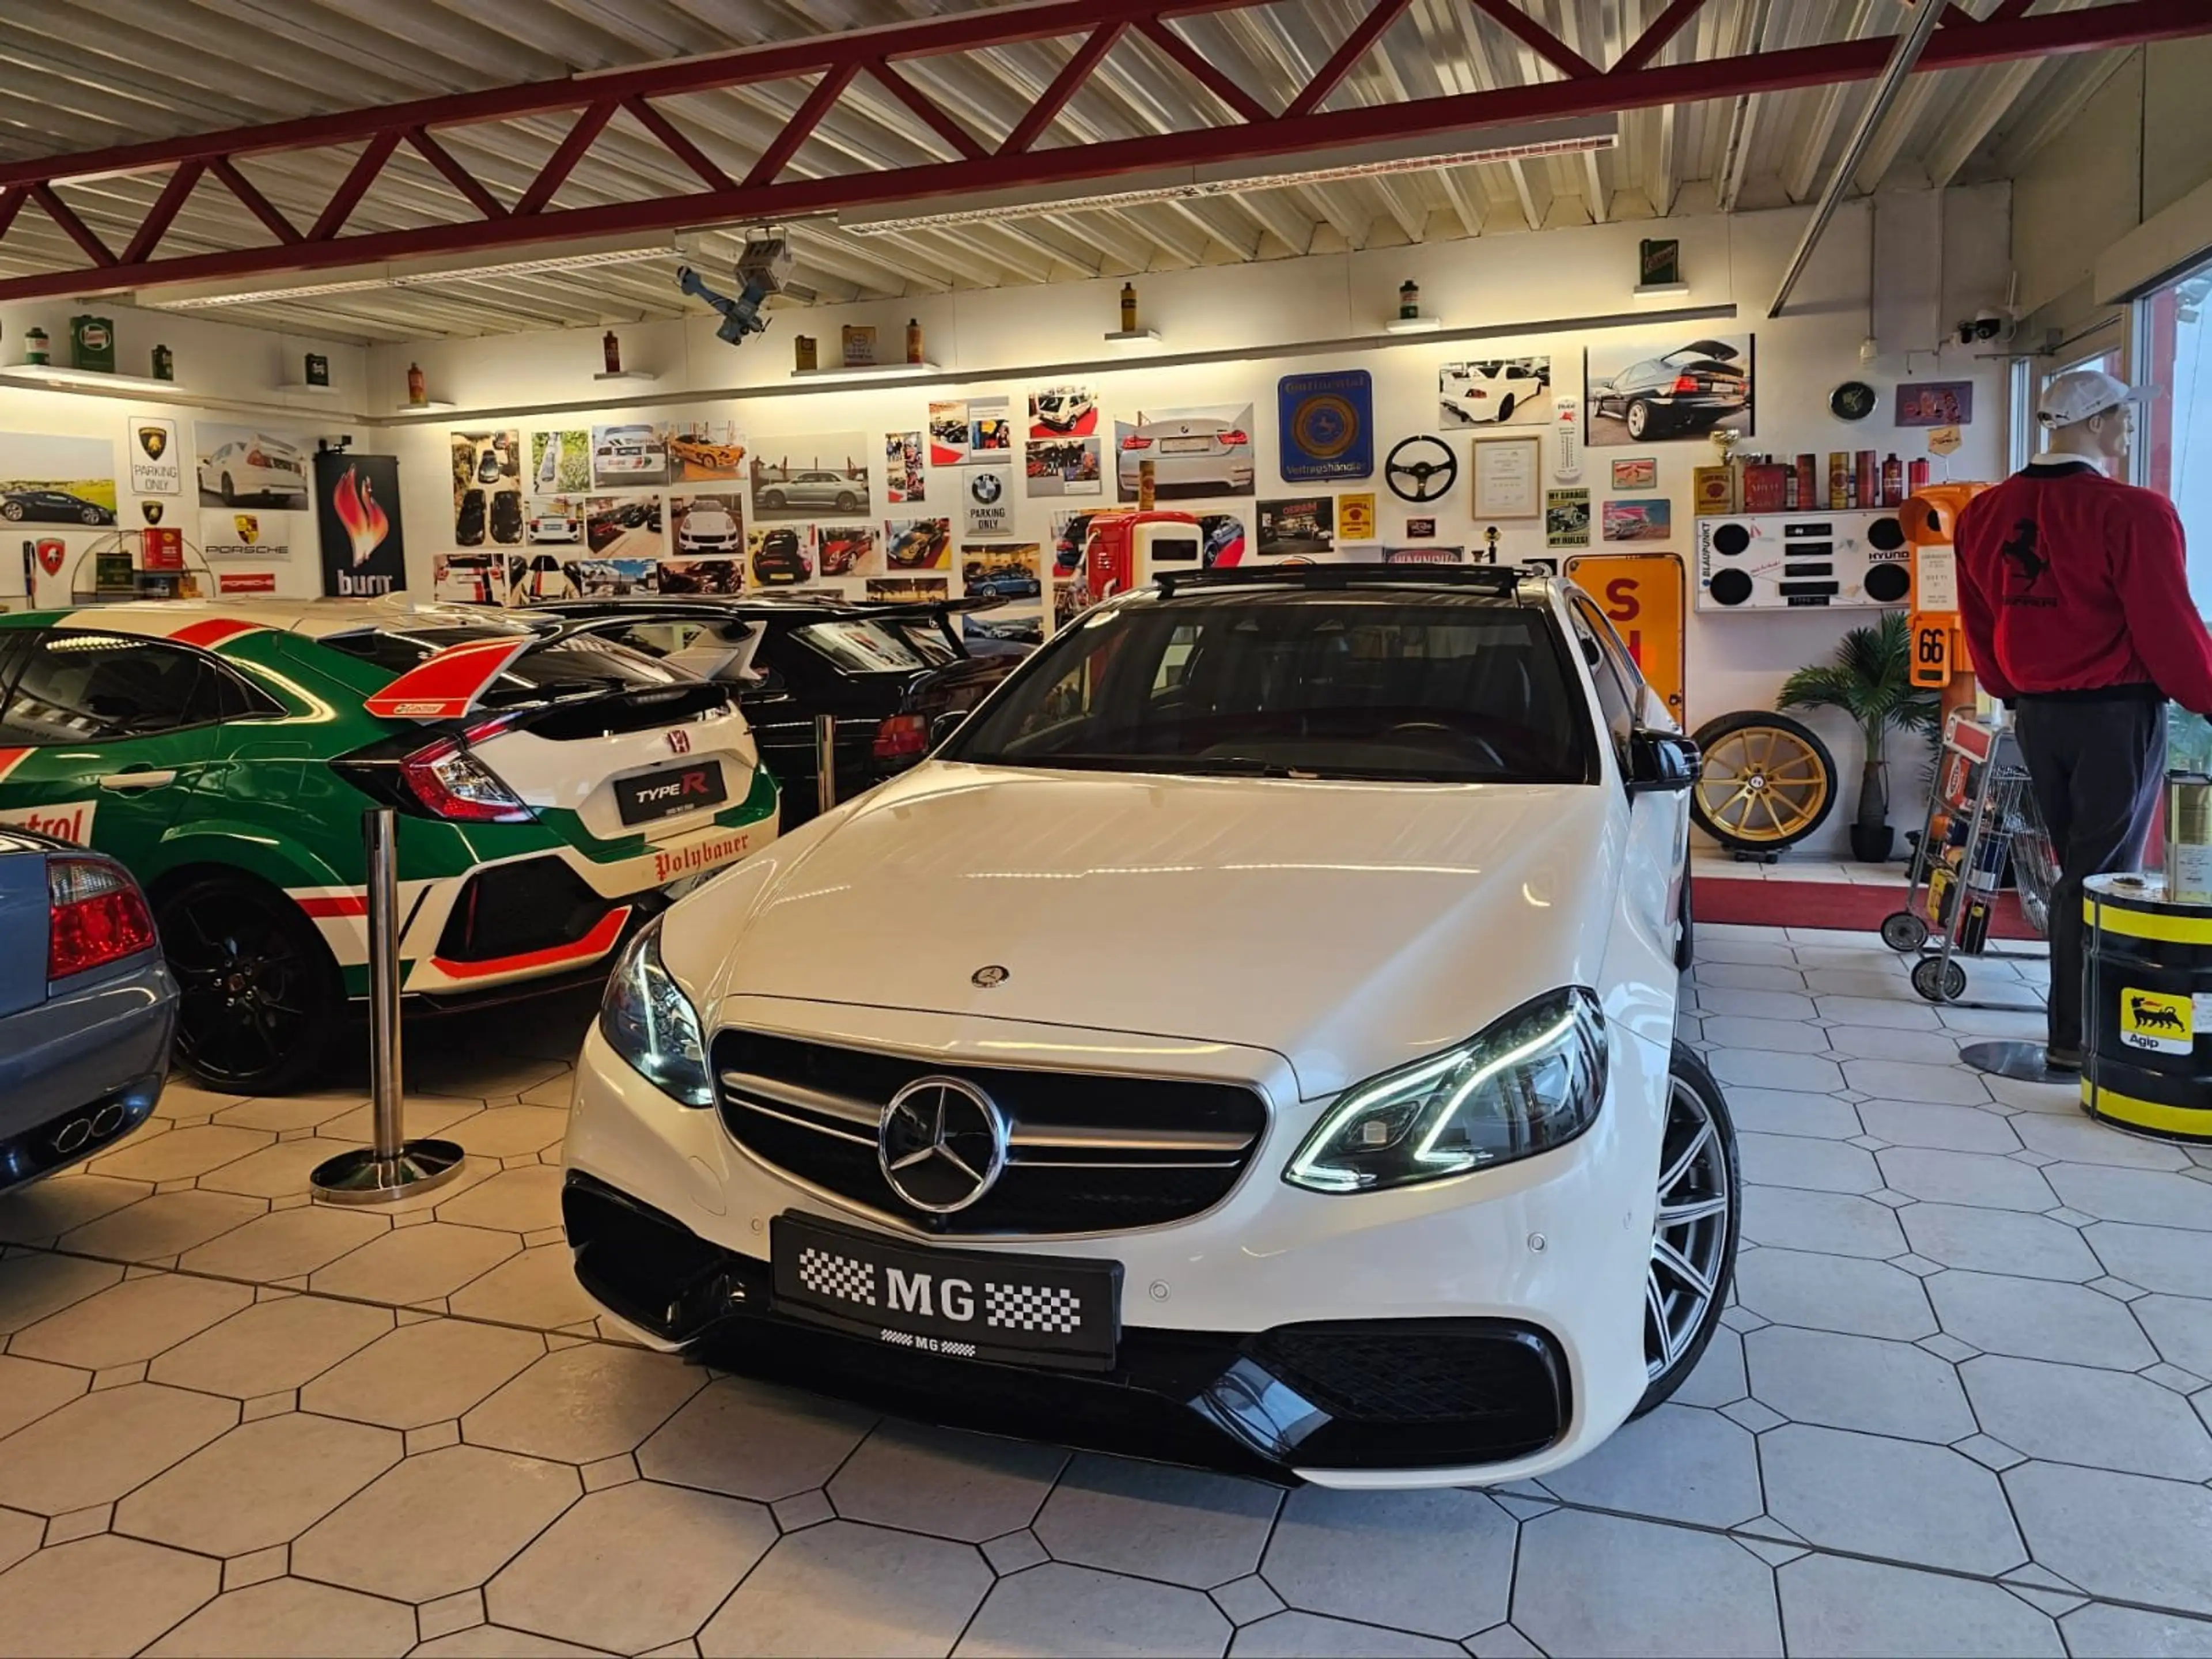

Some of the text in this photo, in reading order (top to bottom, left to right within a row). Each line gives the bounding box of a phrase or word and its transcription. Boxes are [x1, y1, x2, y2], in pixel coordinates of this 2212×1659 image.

[134, 464, 177, 478] PARKING
[145, 479, 168, 490] ONLY
[970, 507, 1005, 518] PARKING
[979, 520, 998, 529] ONLY
[1702, 522, 1710, 577] BLAUPUNKT
[338, 569, 392, 596] burn
[1605, 578, 1640, 621] S
[1919, 628, 1944, 663] 66
[636, 771, 710, 804] TYPE R
[655, 835, 749, 881] Polybauer
[2130, 1034, 2159, 1048] Agip
[886, 1268, 975, 1321] MG
[915, 1336, 938, 1352] MG
